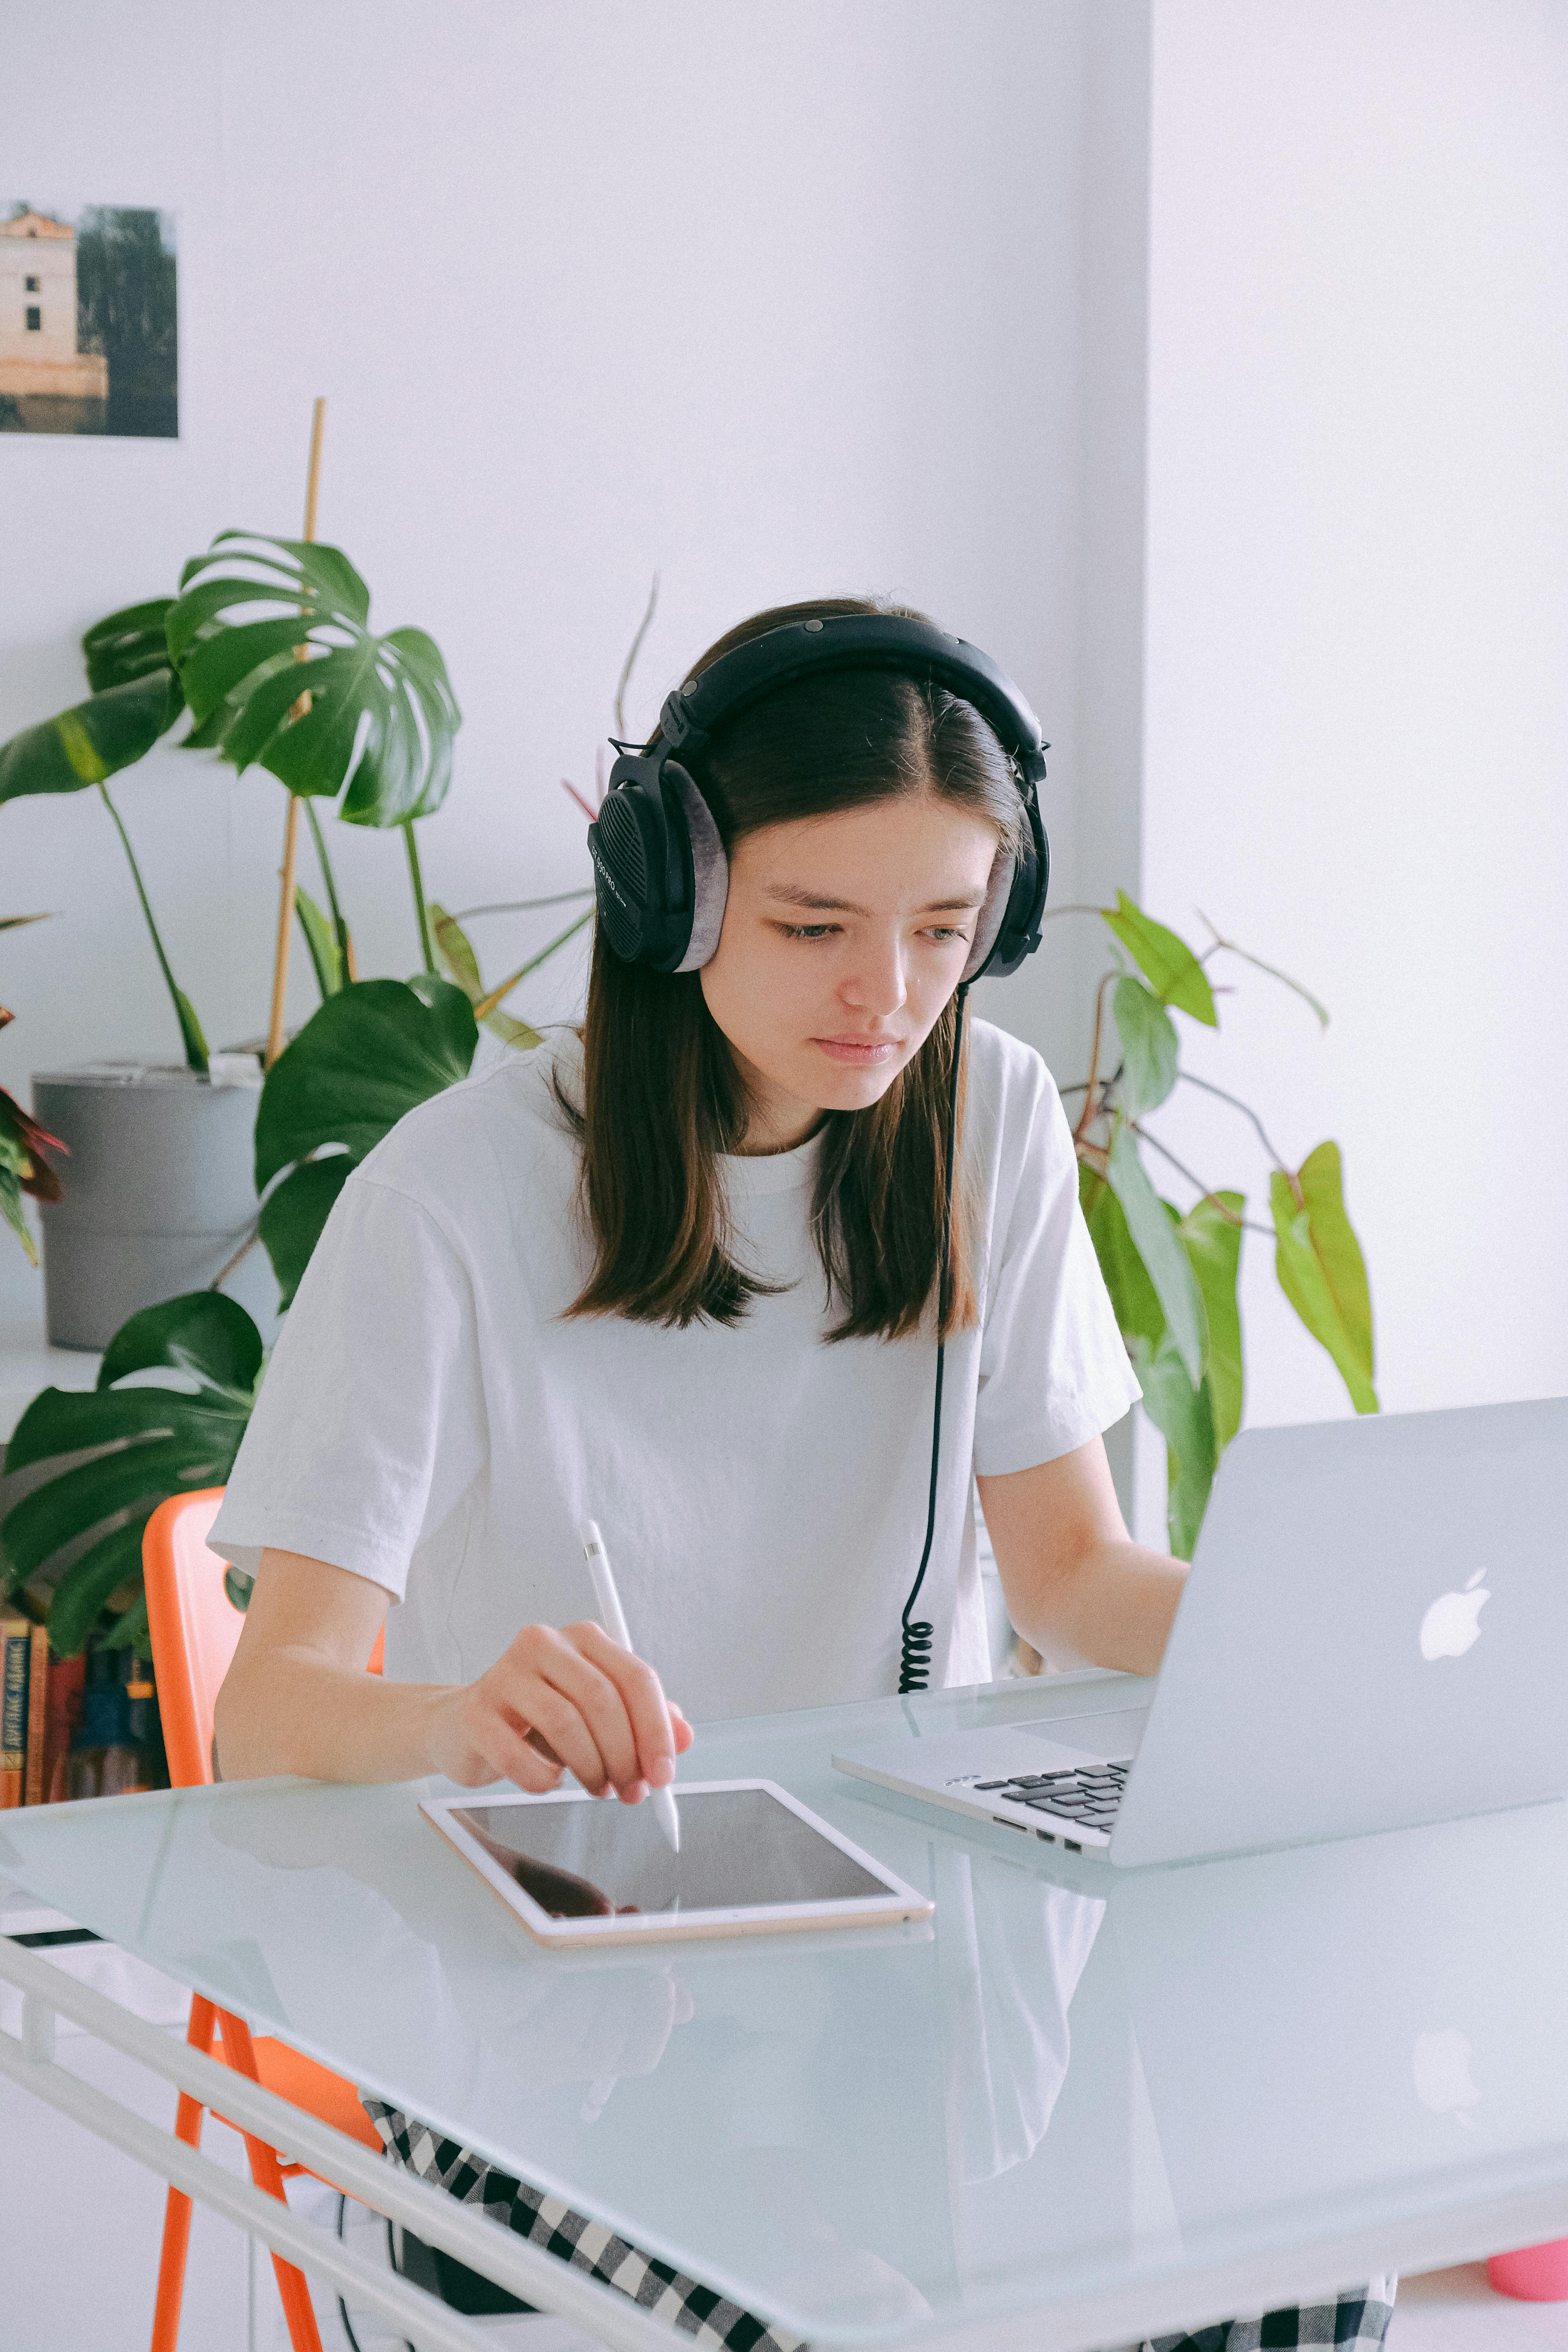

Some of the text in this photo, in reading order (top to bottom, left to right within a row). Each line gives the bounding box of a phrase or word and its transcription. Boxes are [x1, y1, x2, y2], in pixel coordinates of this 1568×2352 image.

[592, 846, 615, 890] DT 990 PRO
